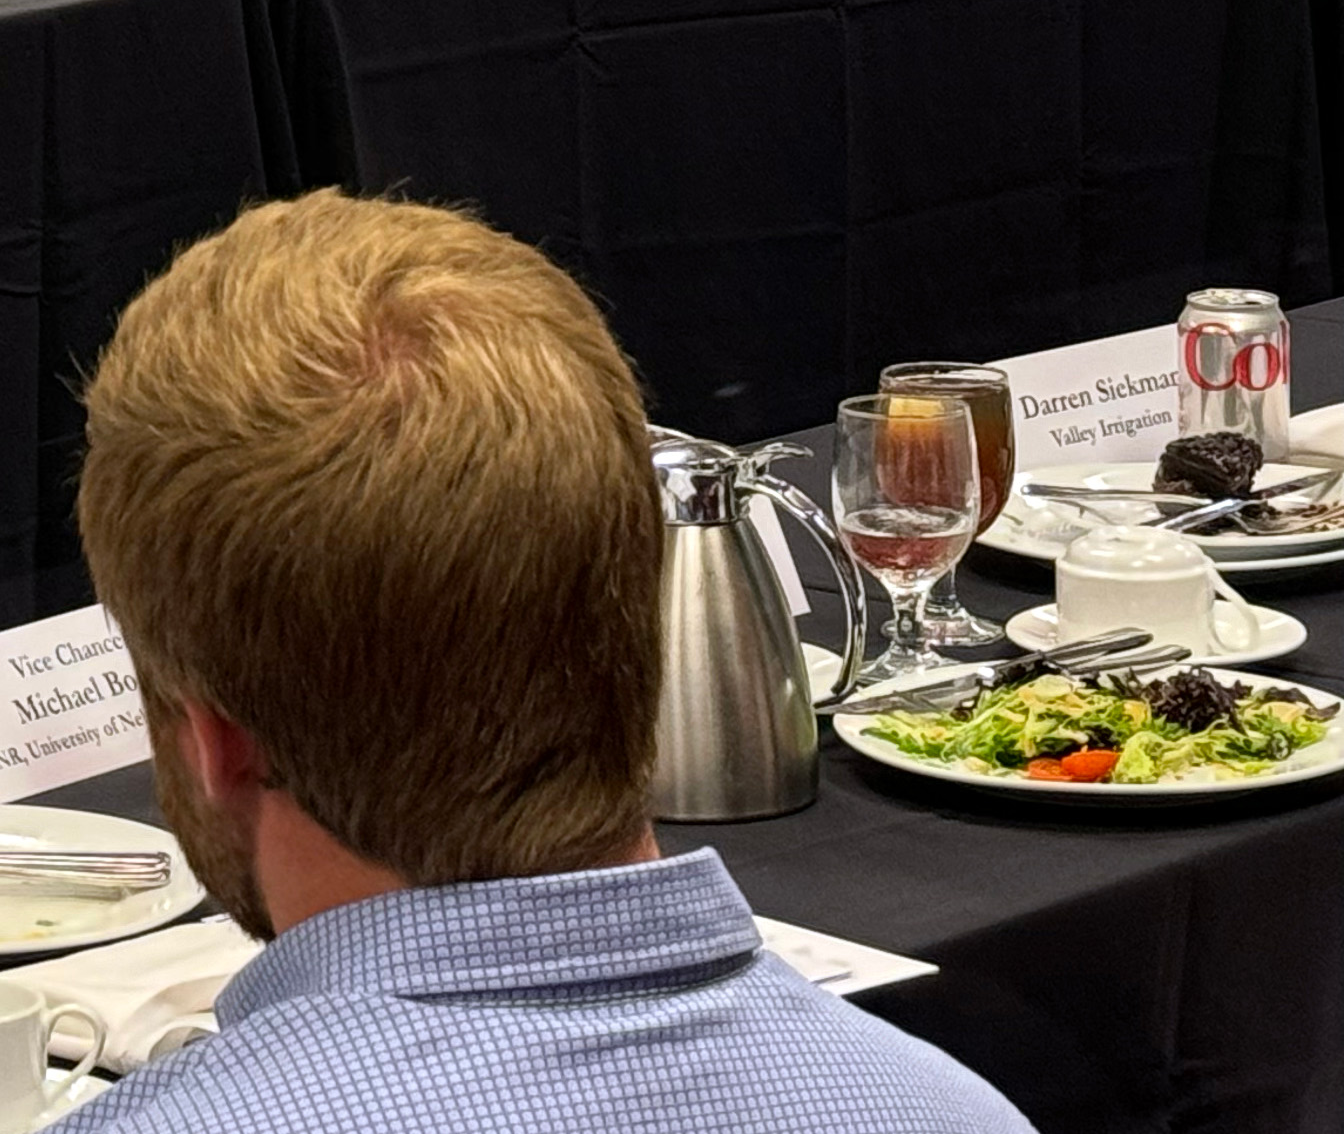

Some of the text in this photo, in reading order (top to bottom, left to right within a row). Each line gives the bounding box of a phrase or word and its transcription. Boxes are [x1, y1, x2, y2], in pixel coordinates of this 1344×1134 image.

[1019, 389, 1093, 421] Darren
[1049, 409, 1173, 449] Valley Irrigation
[8, 634, 123, 680] Vice Chance
[12, 670, 138, 726] Michael Bo
[25, 723, 102, 761] University
[102, 716, 120, 737] of
[117, 708, 146, 728] Ne
